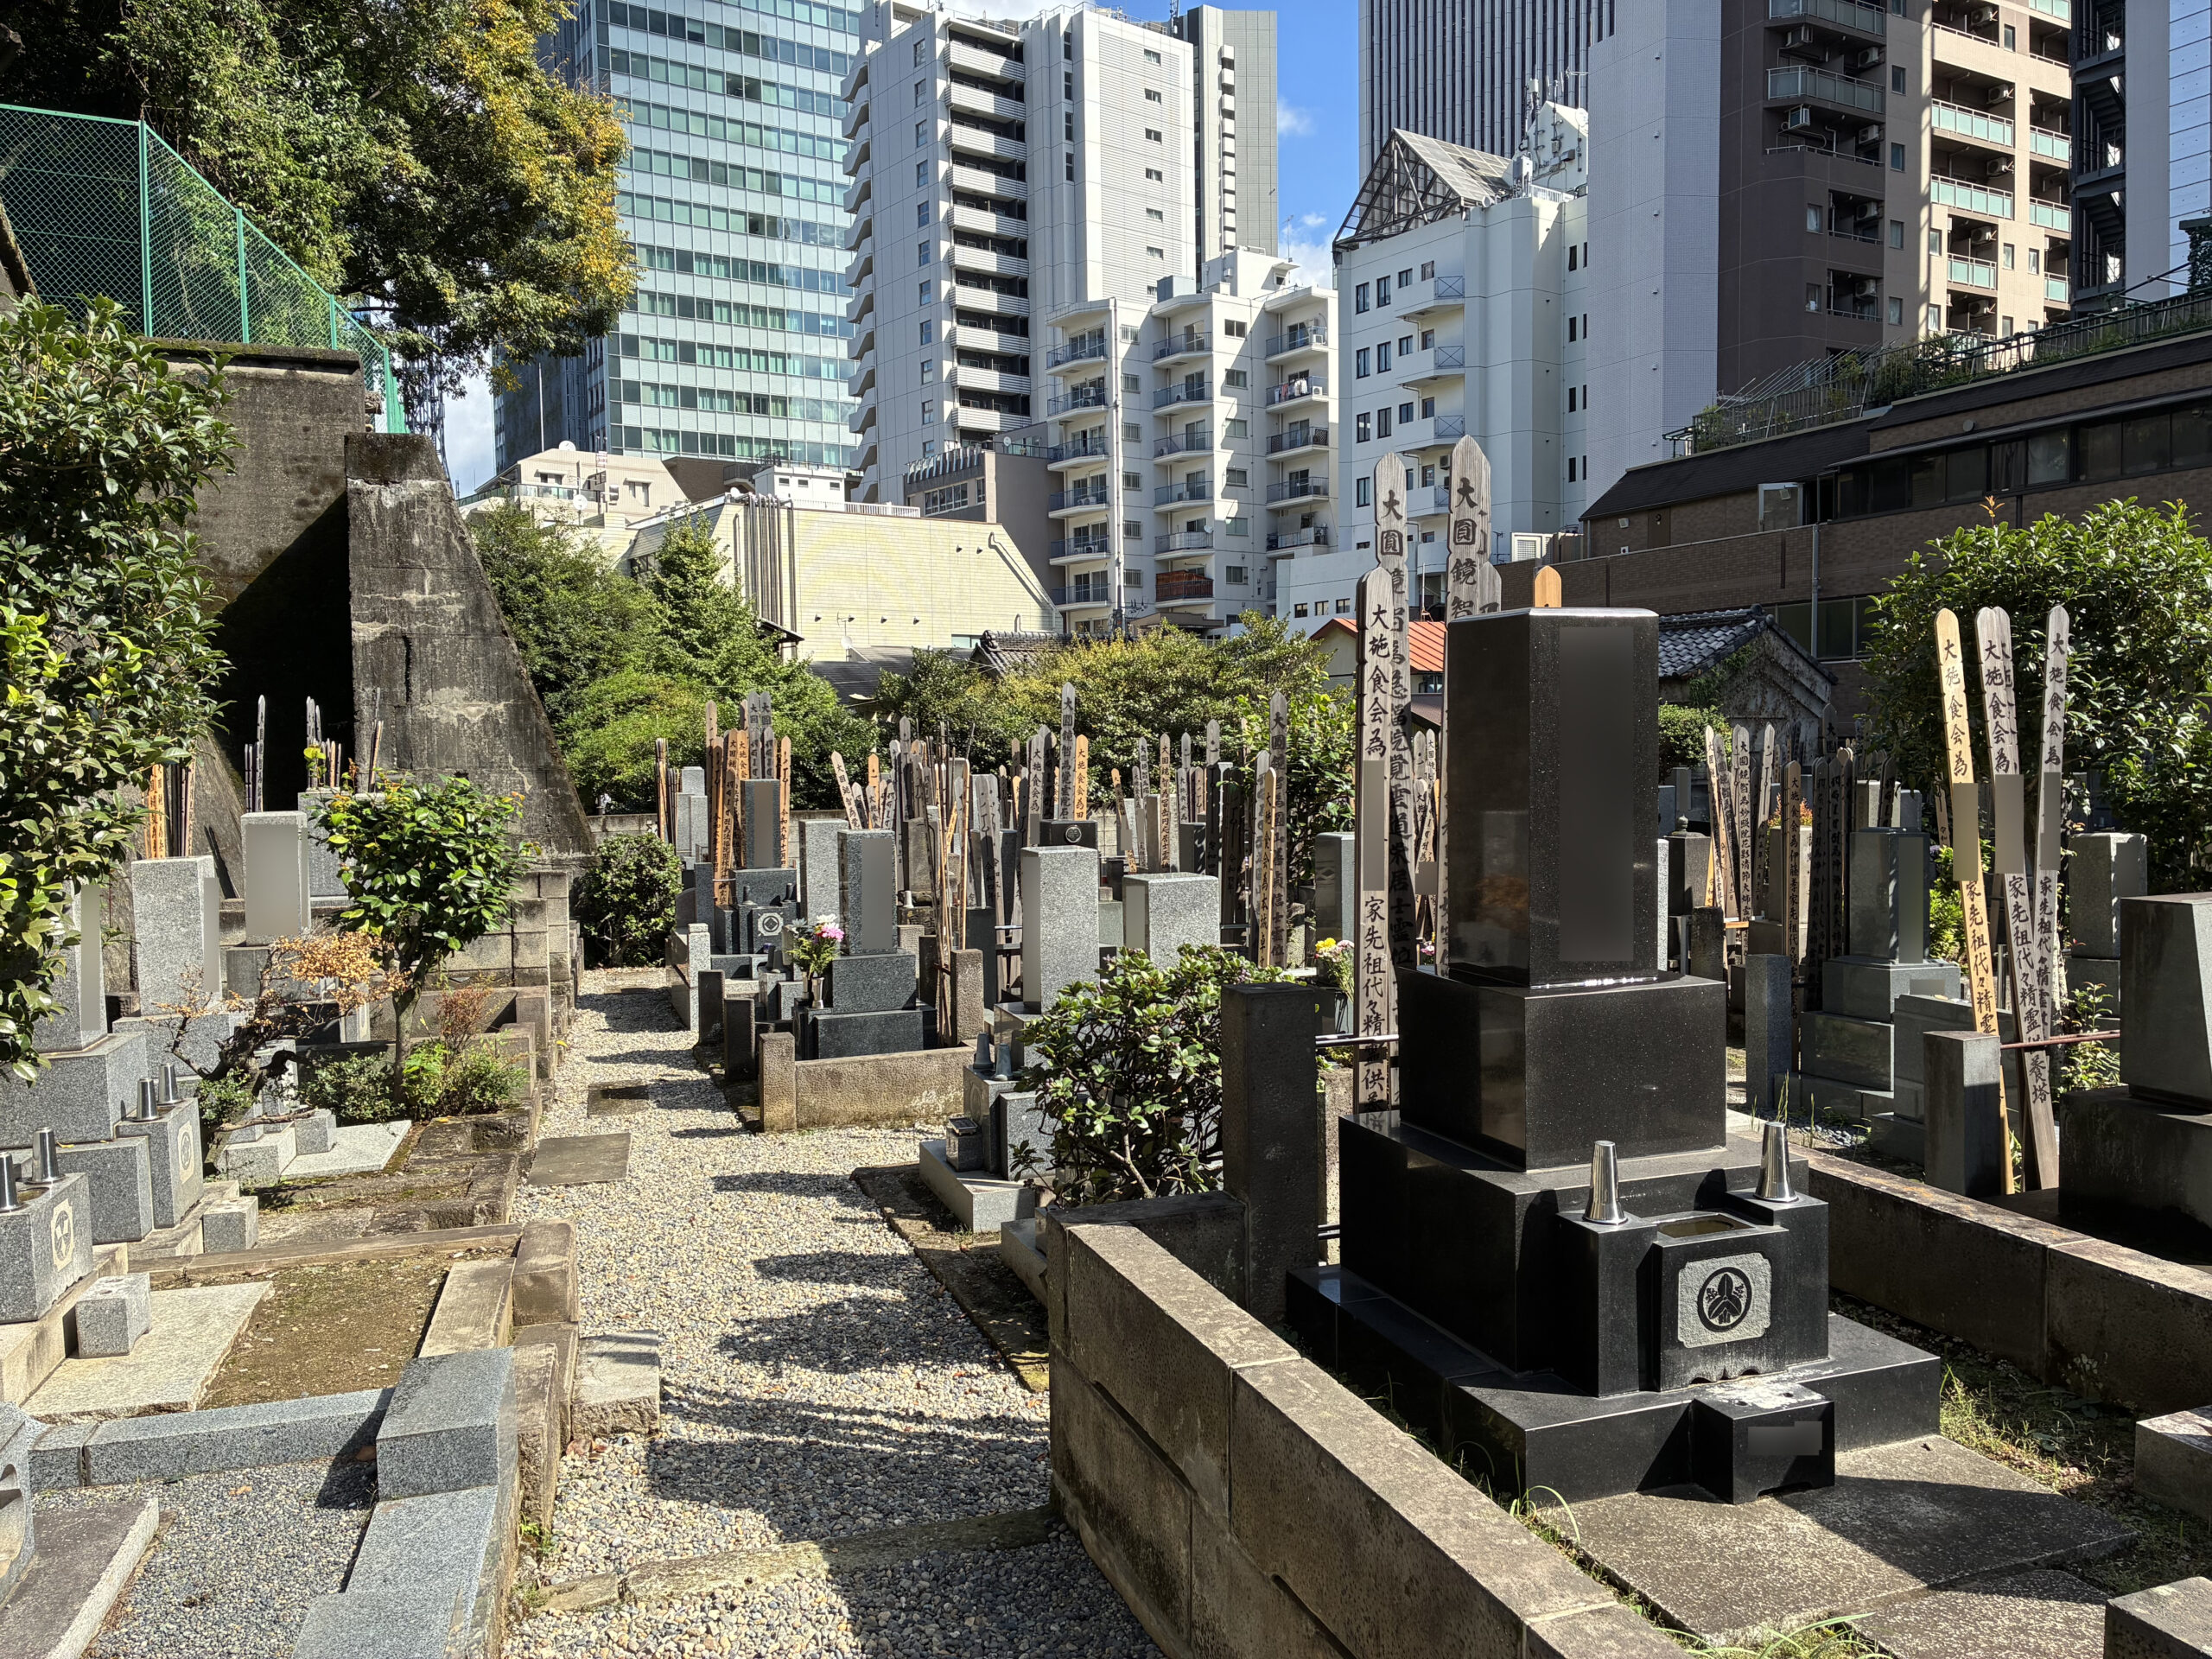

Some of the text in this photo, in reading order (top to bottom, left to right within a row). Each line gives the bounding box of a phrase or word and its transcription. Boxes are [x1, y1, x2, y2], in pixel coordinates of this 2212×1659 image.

[1365, 604, 1390, 757] 大施食会為
[1985, 639, 2010, 773] 大施食会為
[2044, 632, 2065, 765] 大施食会為
[1944, 639, 1996, 1034] 大施食会為 家先祖代々精霊
